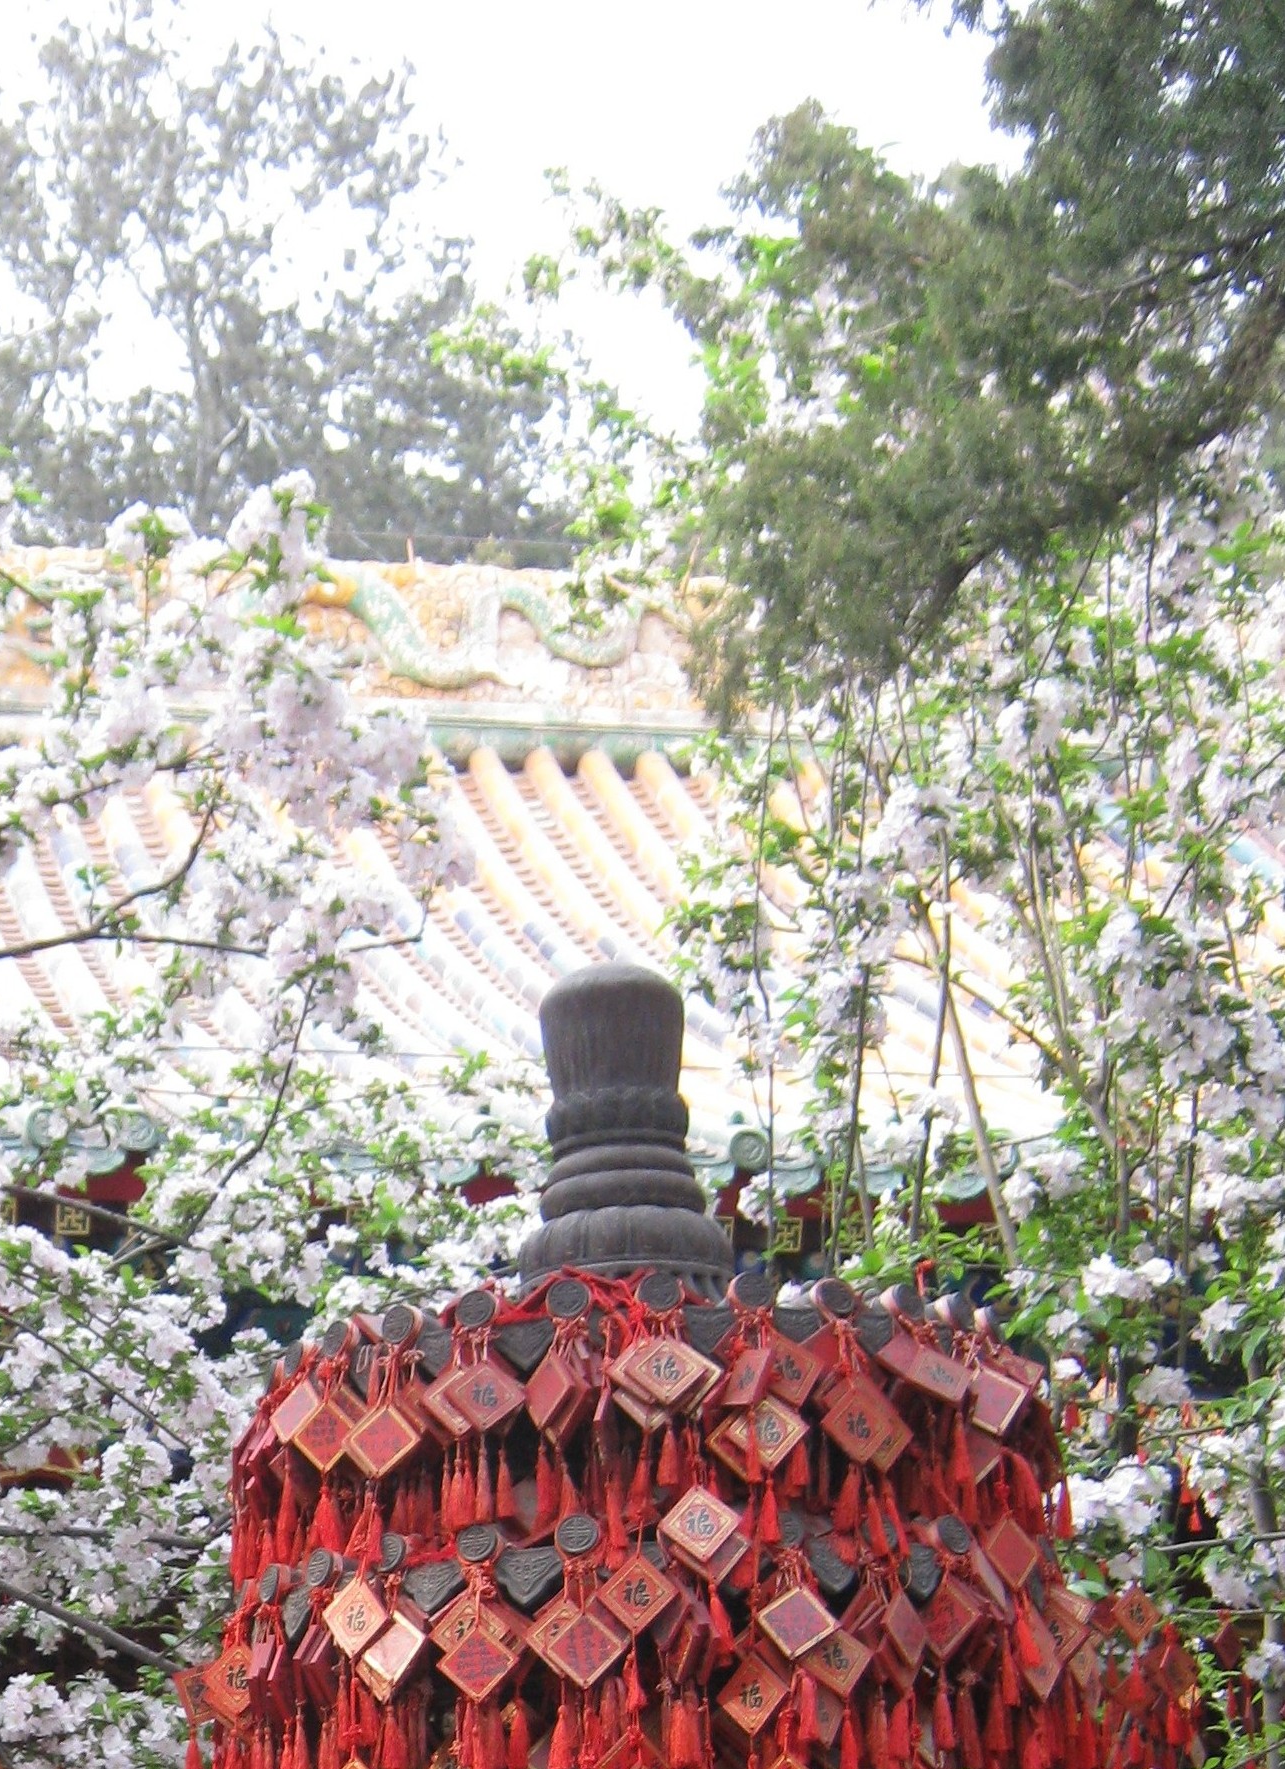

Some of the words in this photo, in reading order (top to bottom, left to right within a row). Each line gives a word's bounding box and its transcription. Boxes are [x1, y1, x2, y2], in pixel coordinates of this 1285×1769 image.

[652, 1355, 681, 1381] 福
[471, 1383, 498, 1408] 福
[846, 1412, 872, 1439] 福
[686, 1508, 714, 1536] 福
[623, 1578, 651, 1607] 福
[346, 1604, 366, 1632] 福
[822, 1643, 850, 1671] 福
[226, 1664, 250, 1690] 福
[740, 1680, 763, 1709] 福
